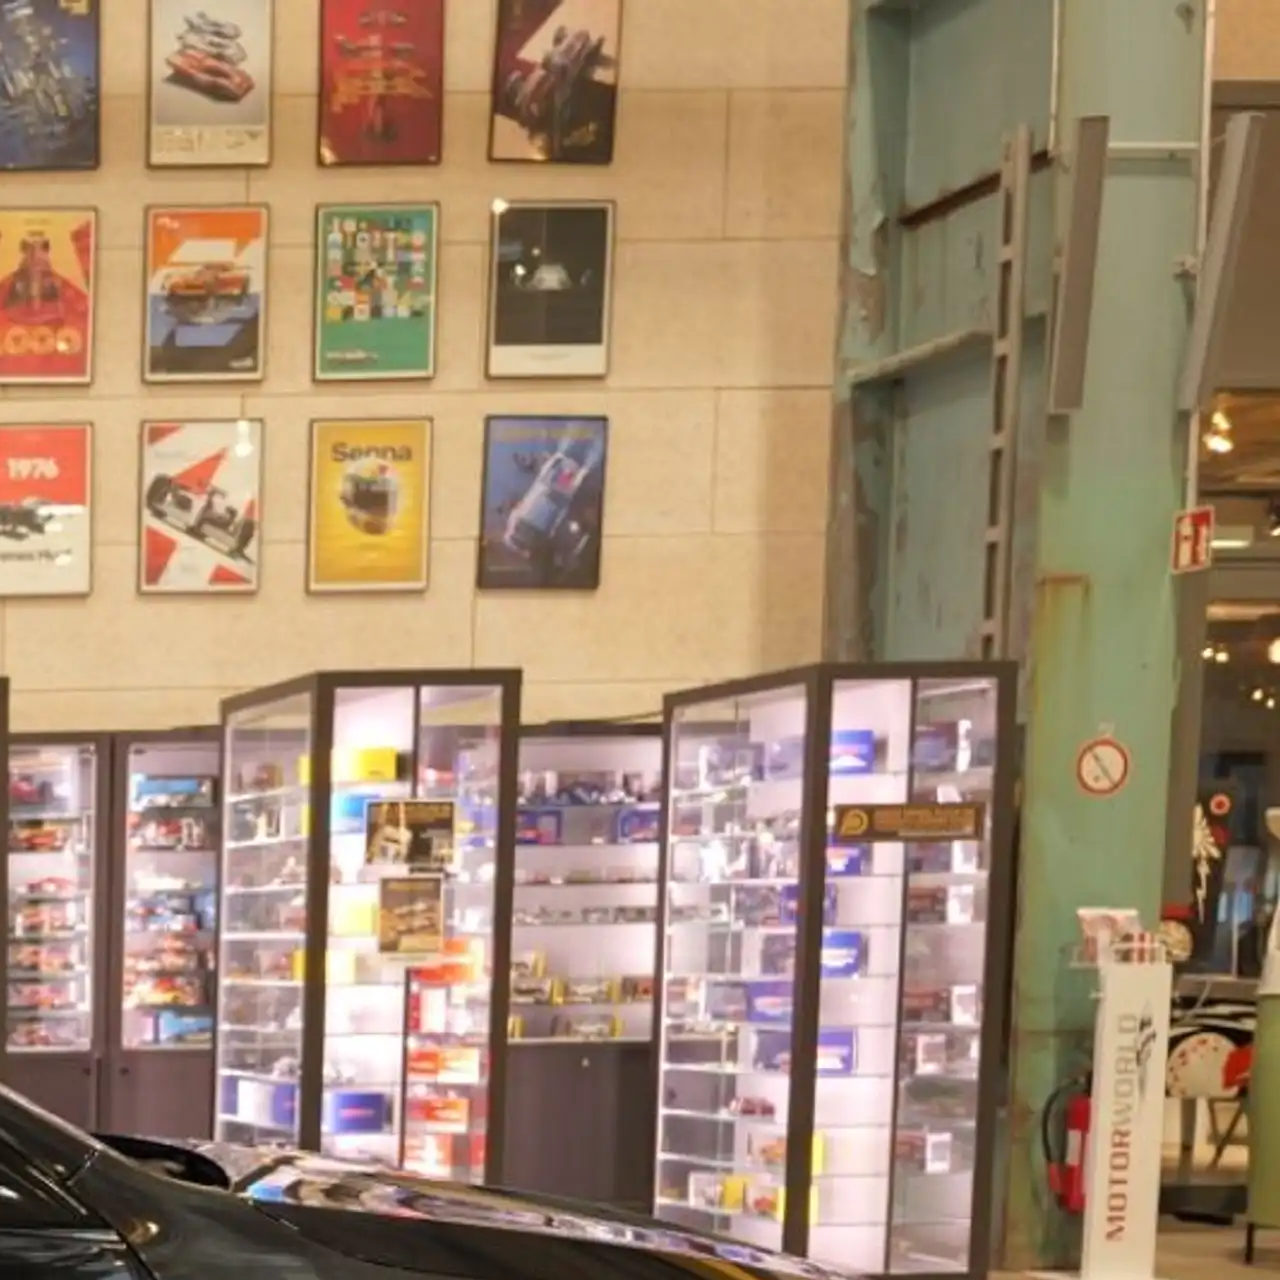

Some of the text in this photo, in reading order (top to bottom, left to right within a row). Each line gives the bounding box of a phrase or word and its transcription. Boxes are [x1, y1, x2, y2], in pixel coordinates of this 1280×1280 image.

[331, 441, 413, 463] Senna
[6, 457, 60, 480] 1976
[1105, 1014, 1138, 1242] MOTORWORLD
